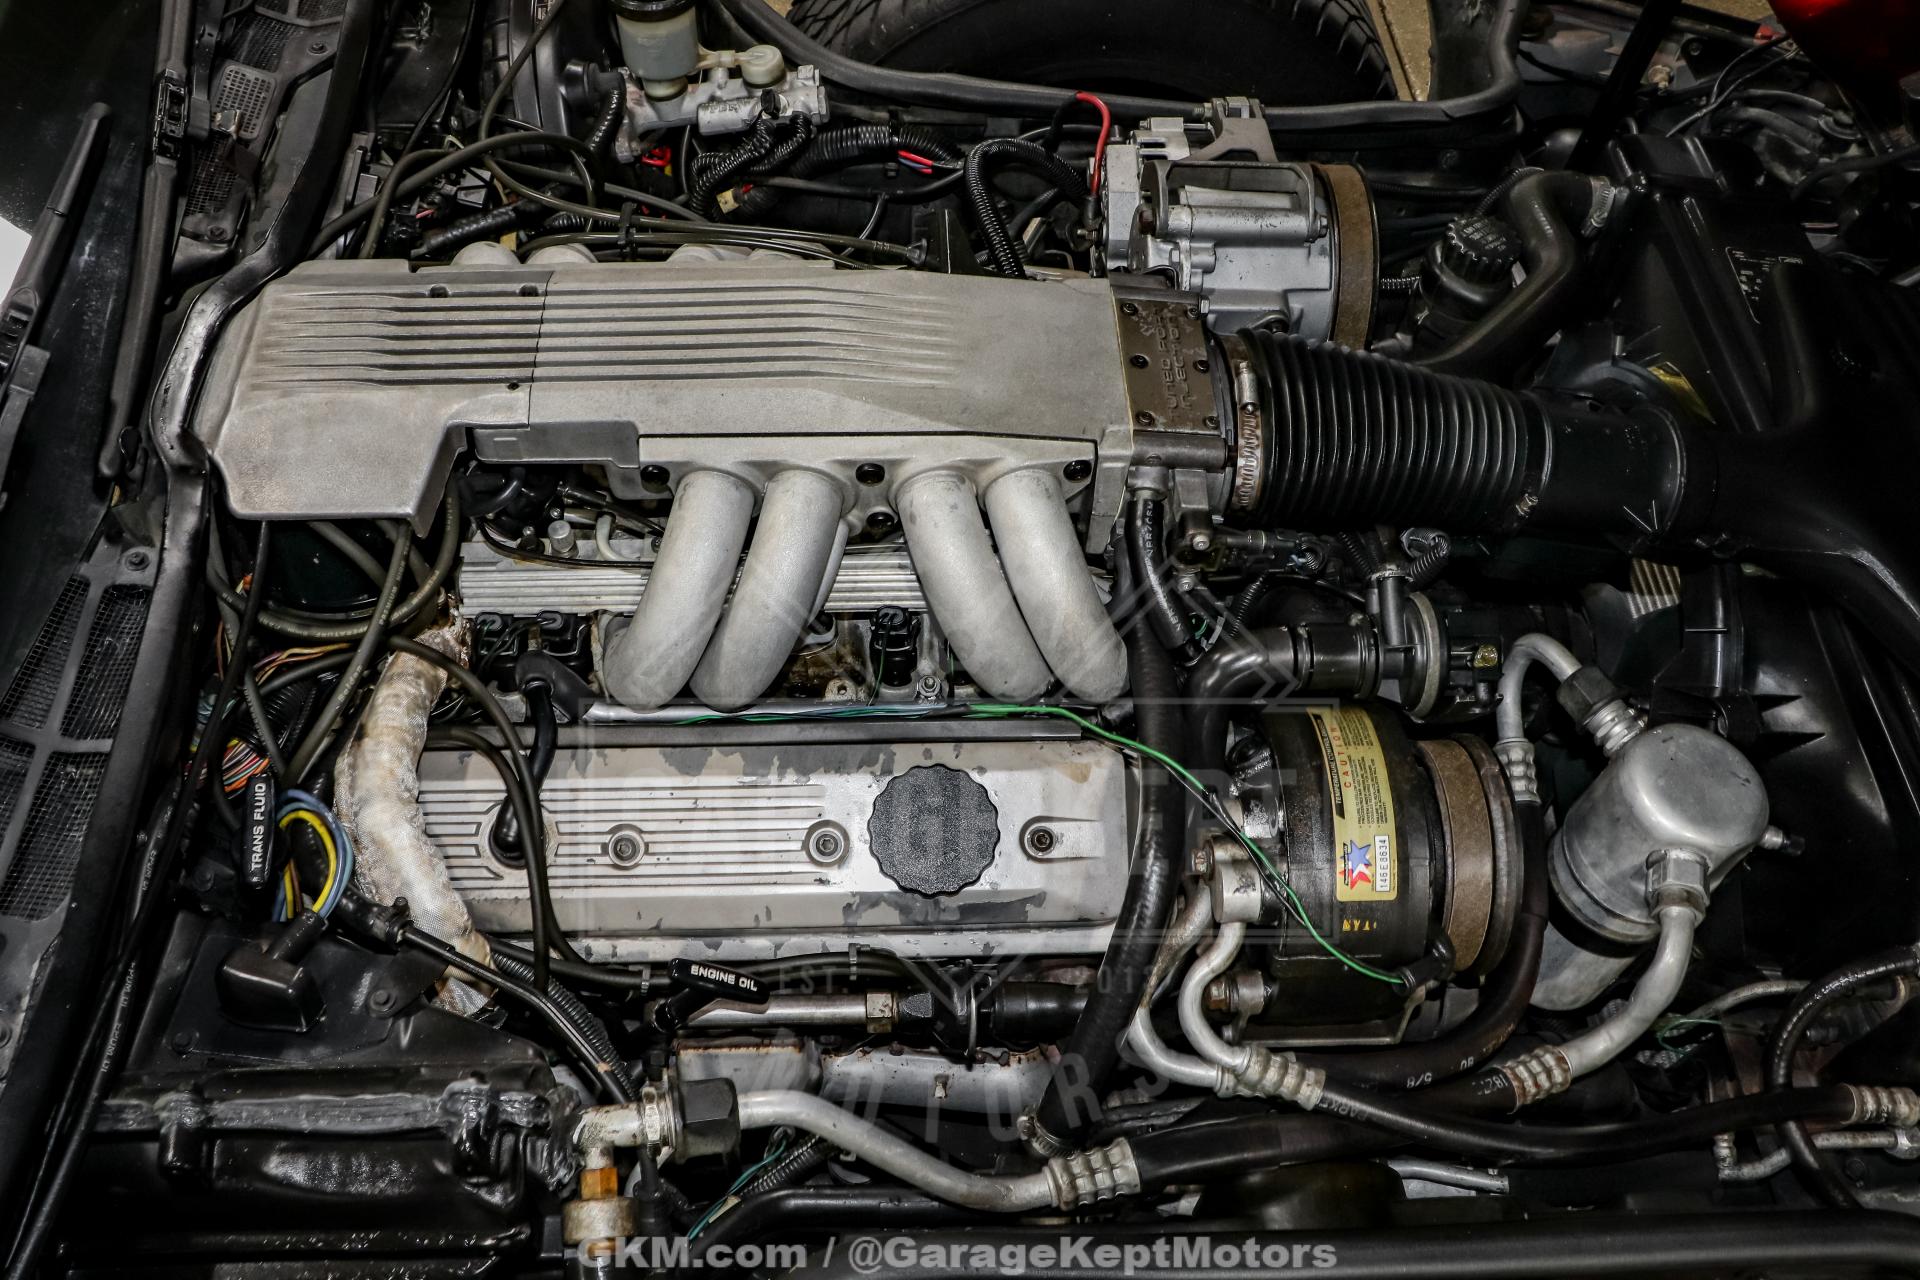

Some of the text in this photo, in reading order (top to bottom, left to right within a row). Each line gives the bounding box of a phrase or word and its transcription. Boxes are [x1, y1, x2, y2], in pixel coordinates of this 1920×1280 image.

[1329, 761, 1342, 804] TEMPERATURE
[1331, 727, 1352, 788] CAUTION
[250, 783, 267, 871] TRANS FLUID
[690, 964, 758, 992] ENGINE OIL
